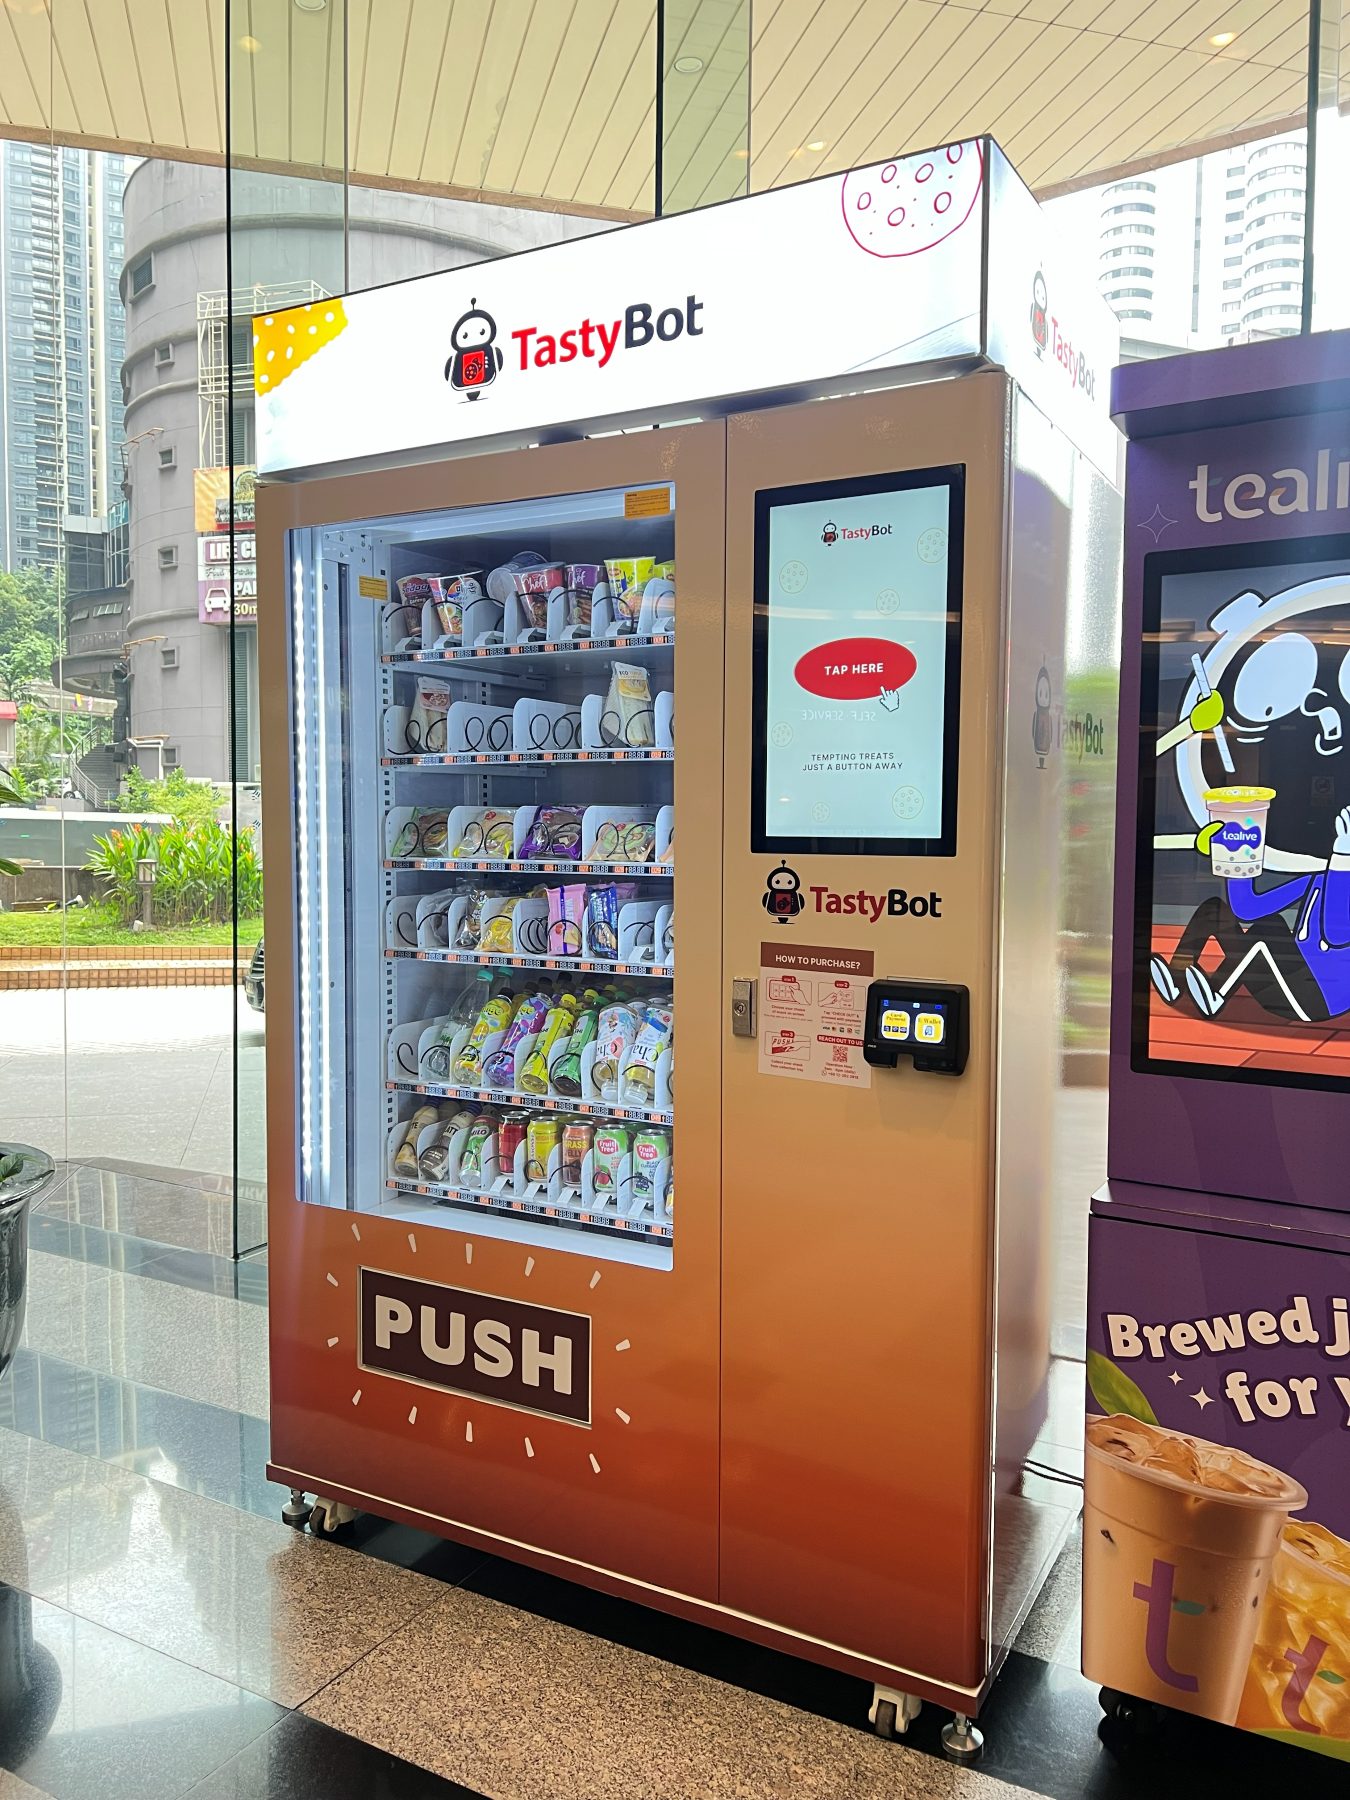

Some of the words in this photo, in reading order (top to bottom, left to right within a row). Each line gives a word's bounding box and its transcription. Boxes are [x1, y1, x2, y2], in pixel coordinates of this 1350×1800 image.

[512, 295, 703, 370] TastyBot
[1051, 316, 1095, 401] TastyBot
[841, 524, 892, 540] TastyBot
[824, 665, 848, 676] TAP
[852, 663, 884, 674] HERE
[811, 753, 856, 761] TEMPTING
[859, 752, 894, 760] TREATS
[835, 762, 872, 770] BUTTON
[875, 762, 903, 770] AWAY
[1222, 830, 1258, 841] tealive
[809, 886, 942, 923] TastyBot
[775, 955, 796, 964] HOW
[797, 956, 809, 964] TO
[811, 957, 860, 969] PURCHASE?
[1107, 1297, 1320, 1358] Brewed
[376, 1295, 572, 1395] PUSH
[1225, 1372, 1318, 1422] for
